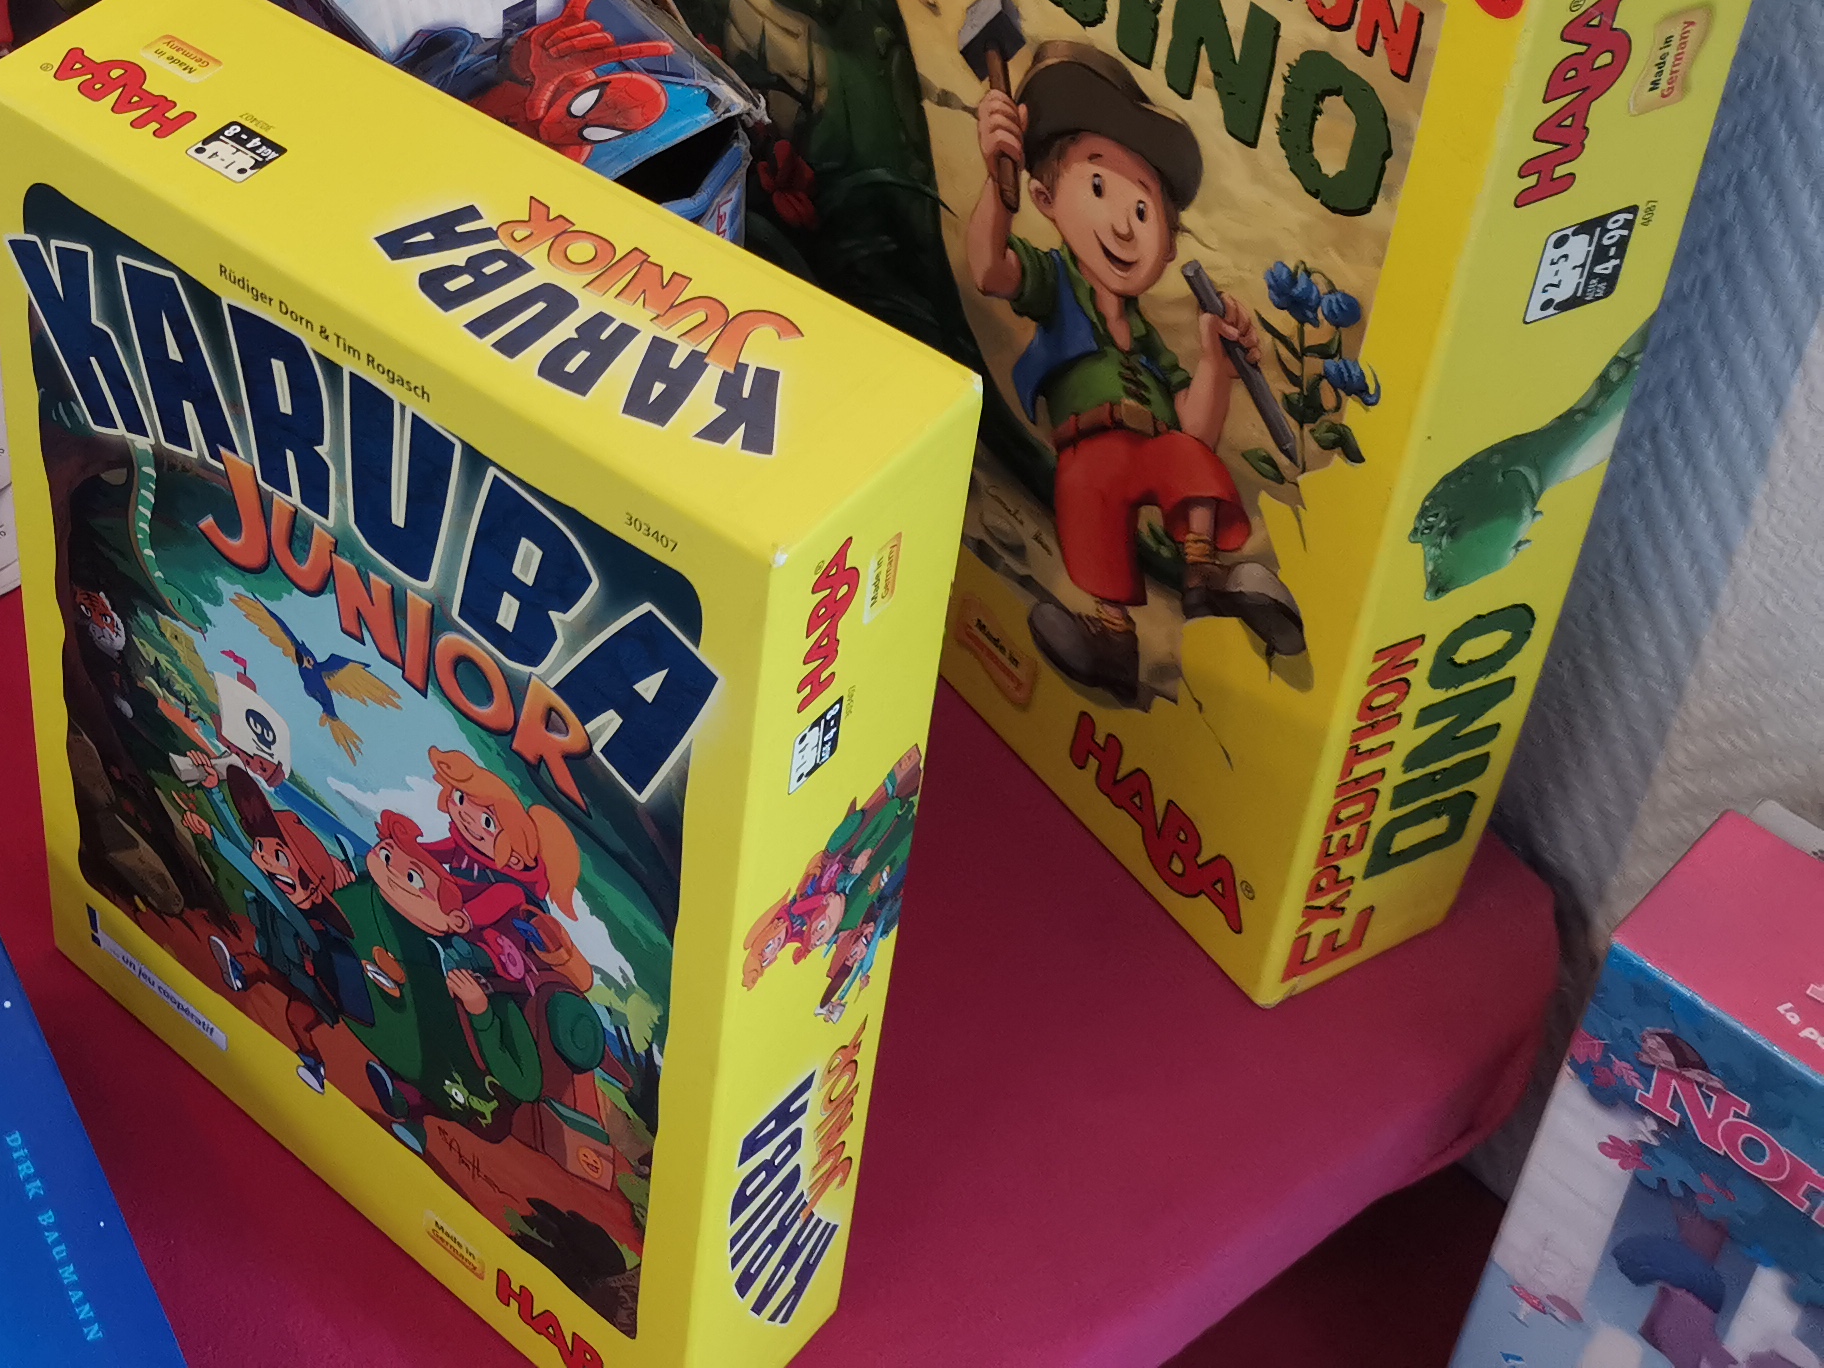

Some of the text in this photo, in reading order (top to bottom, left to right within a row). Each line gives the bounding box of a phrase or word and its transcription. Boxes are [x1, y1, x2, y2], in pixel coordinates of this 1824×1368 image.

[53, 47, 197, 139] HABA
[154, 46, 197, 77] Made in
[163, 38, 213, 70] Germany
[1648, 34, 1675, 94] Made in
[1660, 19, 1697, 100] Germany
[498, 196, 805, 373] JUNIOR
[1640, 199, 1658, 227] 4087
[218, 261, 432, 403] Rüdiger Dorn & Tim Rogasch
[372, 205, 781, 456] KARUBA
[5, 232, 725, 805] KARUBA
[623, 510, 679, 553] 303407
[197, 444, 594, 812] JUNIOR
[796, 535, 860, 714] HABA
[1280, 633, 1427, 983] EXPEDITION
[1363, 602, 1537, 883] DINO
[1069, 710, 1243, 935] HABA
[122, 953, 215, 1037] un jeu coopératif
[798, 1013, 868, 1222] JUNIOR
[4, 1130, 105, 1342] DIRK BAUMANN
[431, 1227, 480, 1277] Germany
[433, 1218, 477, 1261] Made in
[729, 1069, 840, 1326] KARUBA
